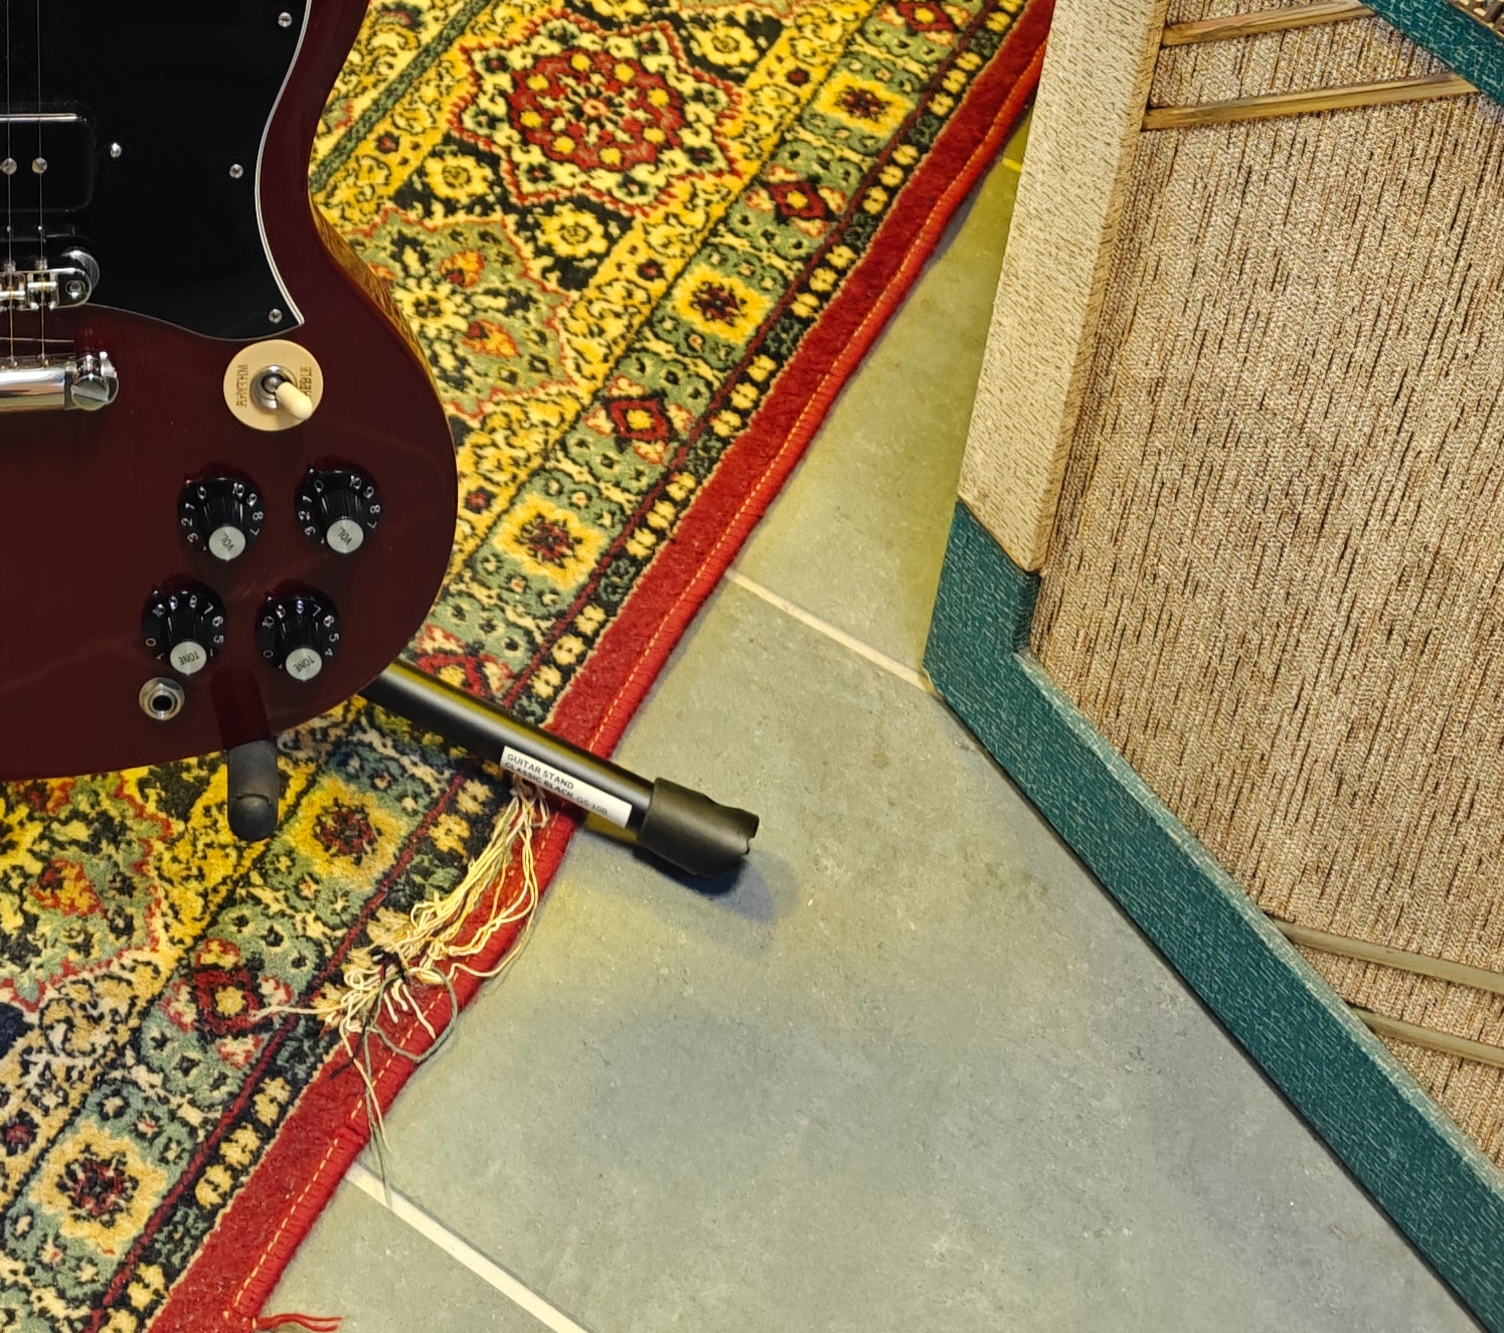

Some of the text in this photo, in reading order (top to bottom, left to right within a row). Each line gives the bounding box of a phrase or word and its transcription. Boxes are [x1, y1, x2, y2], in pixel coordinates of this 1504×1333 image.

[369, 504, 381, 514] 8
[252, 511, 264, 521] 8
[181, 517, 193, 527] 2
[187, 532, 199, 544] 3
[304, 525, 316, 536] 3
[366, 520, 378, 529] 7
[249, 528, 261, 536] 7
[338, 526, 353, 546] VOL
[221, 532, 235, 552] VOL
[204, 602, 215, 615] 7
[312, 604, 322, 618] 7
[212, 615, 224, 627] 6
[145, 637, 157, 647] 0
[213, 634, 225, 645] 5
[328, 632, 340, 643] 5
[177, 650, 201, 666] TONE
[262, 649, 274, 659] 0
[292, 655, 316, 673] TONE
[506, 753, 575, 790] GUITAR STAND
[504, 761, 542, 784] CLASSIC
[543, 780, 575, 800] BLACK
